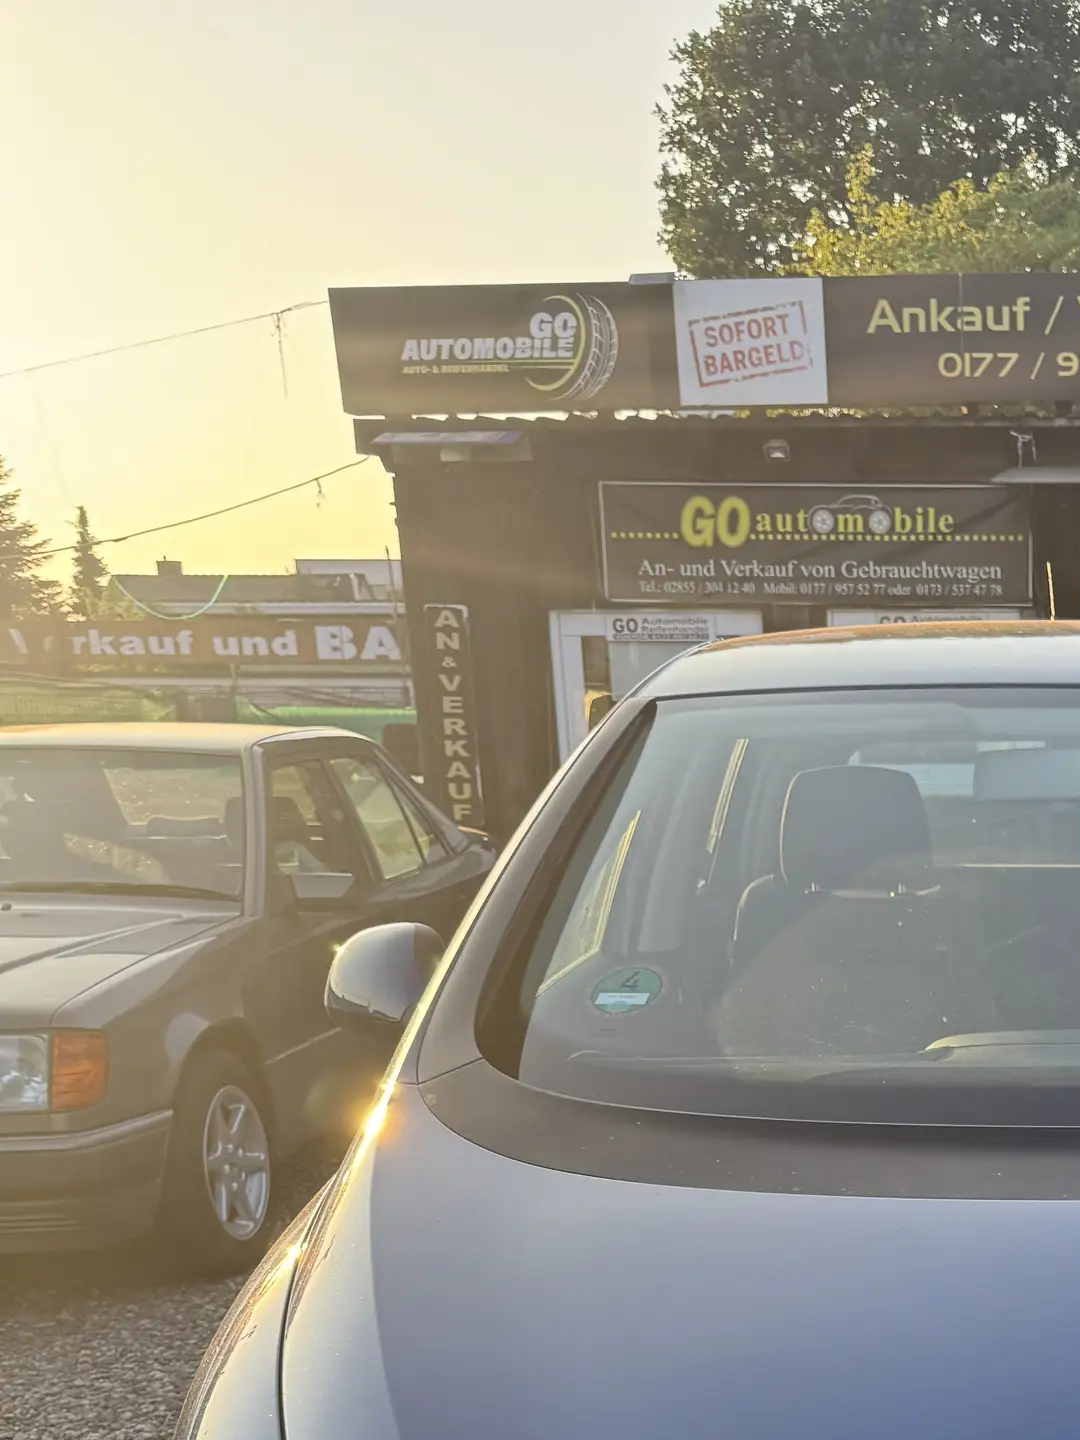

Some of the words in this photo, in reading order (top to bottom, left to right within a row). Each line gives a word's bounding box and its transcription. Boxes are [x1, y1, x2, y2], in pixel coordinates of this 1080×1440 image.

[530, 312, 577, 339] GO
[866, 297, 1031, 334] Ankauf
[1044, 296, 1064, 335] /
[704, 313, 789, 348] SOFORT
[401, 337, 575, 361] AUTOMOBILE
[704, 340, 804, 376] BARGELD
[937, 352, 1020, 378] 0177
[1030, 352, 1046, 380] /
[681, 496, 750, 547] GO
[638, 559, 675, 576] An-
[680, 558, 715, 577] und
[720, 559, 798, 578] Verkauf
[801, 565, 836, 579] von
[840, 560, 1002, 583] Gebrauchtwagen
[434, 609, 460, 650] AN
[613, 618, 638, 633] GO
[212, 629, 299, 656] und
[441, 656, 458, 668] &
[438, 674, 472, 821] VERKAUF
[620, 971, 640, 991] 4
